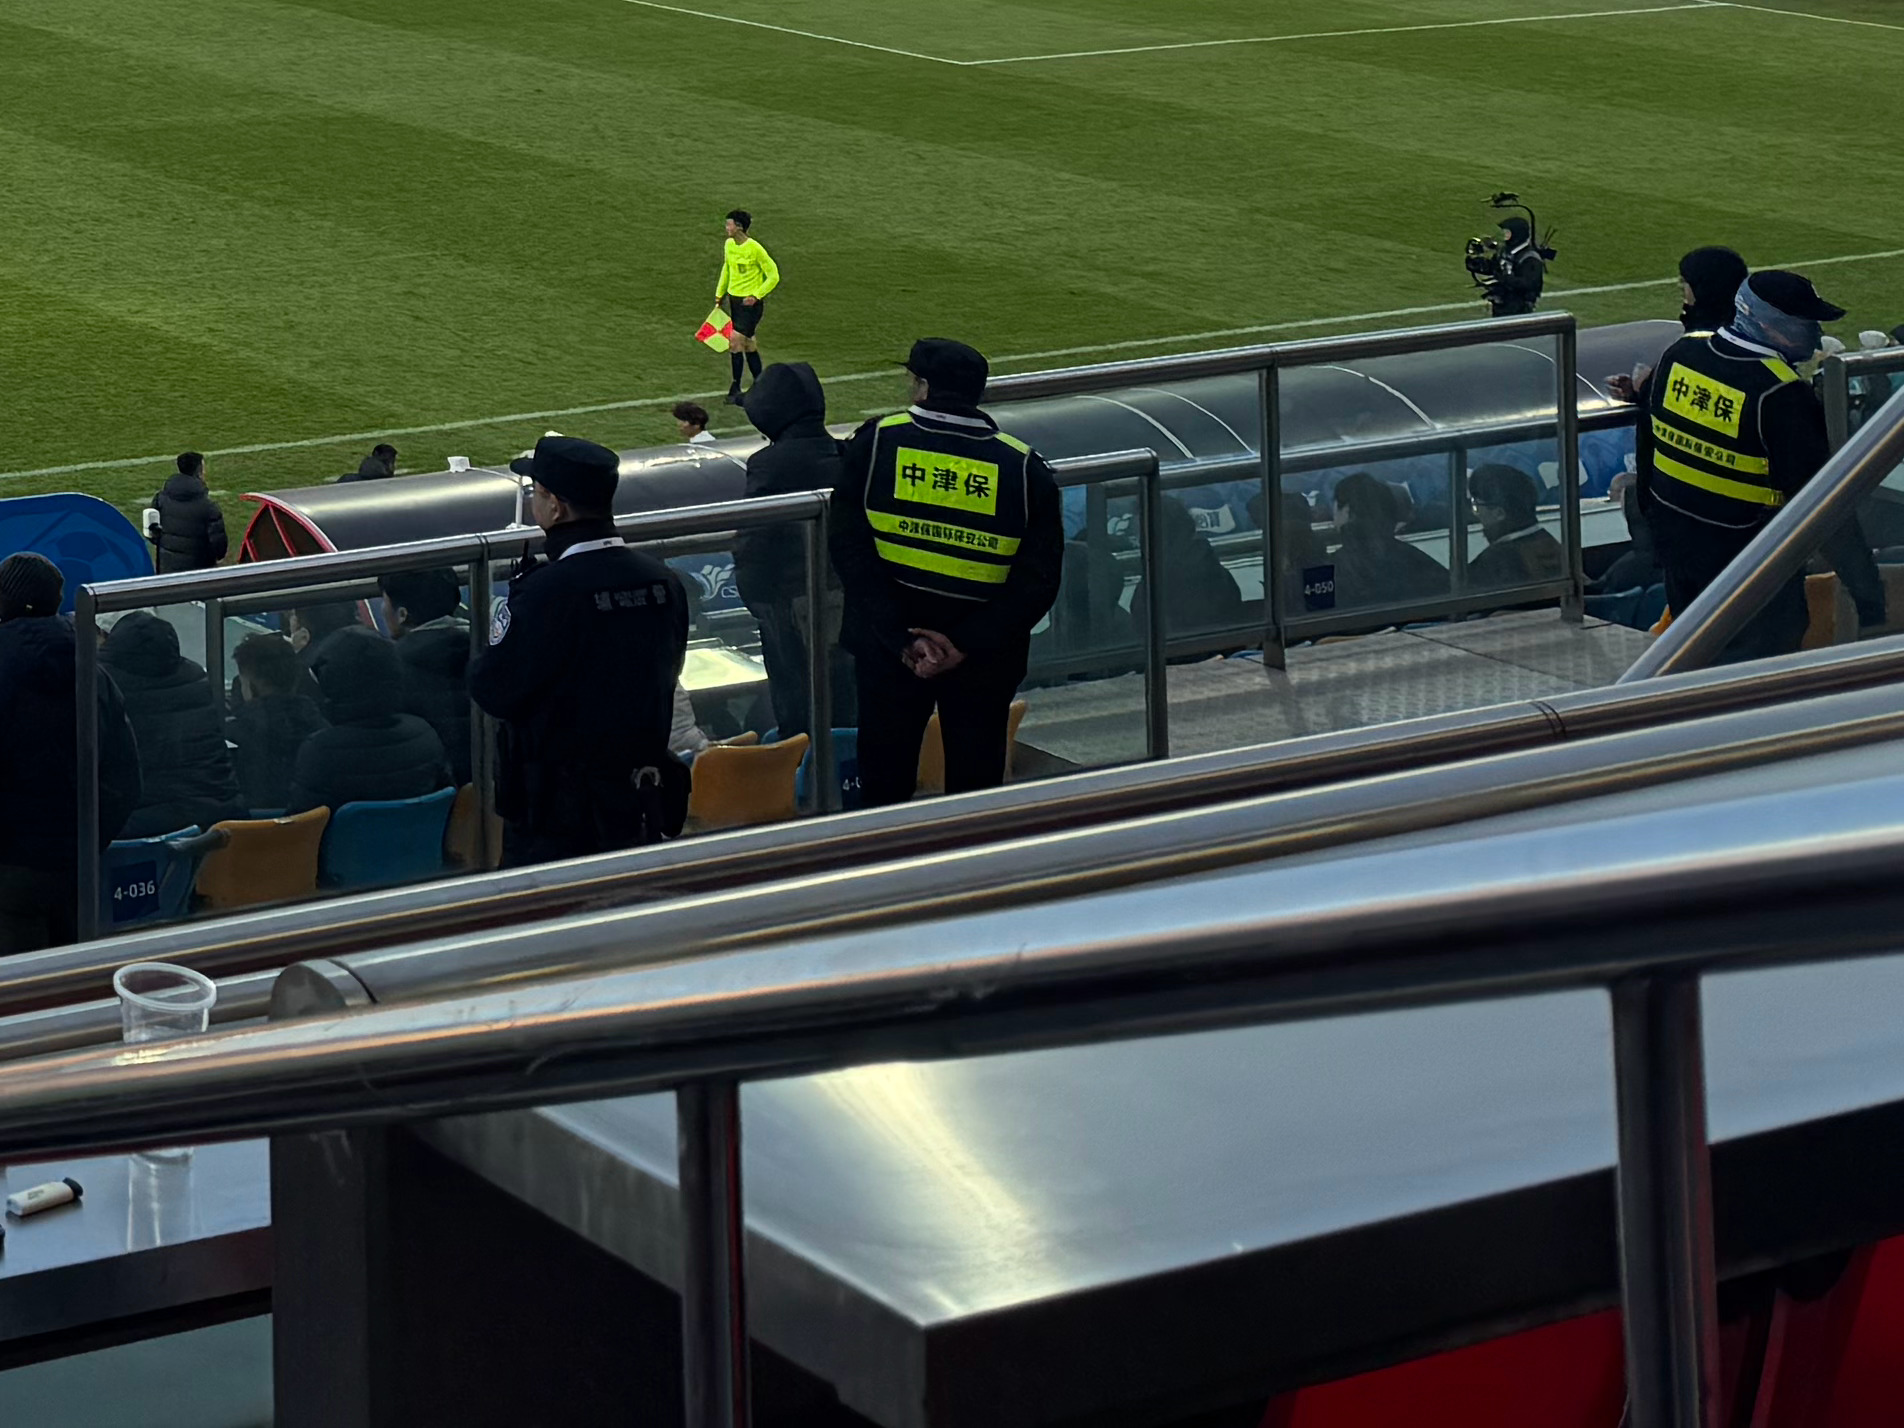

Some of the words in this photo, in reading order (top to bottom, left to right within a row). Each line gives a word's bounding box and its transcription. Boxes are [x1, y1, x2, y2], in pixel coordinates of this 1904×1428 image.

[1671, 376, 1735, 425] 中津保
[901, 462, 991, 499] 中津保
[113, 879, 156, 901] 4-036
